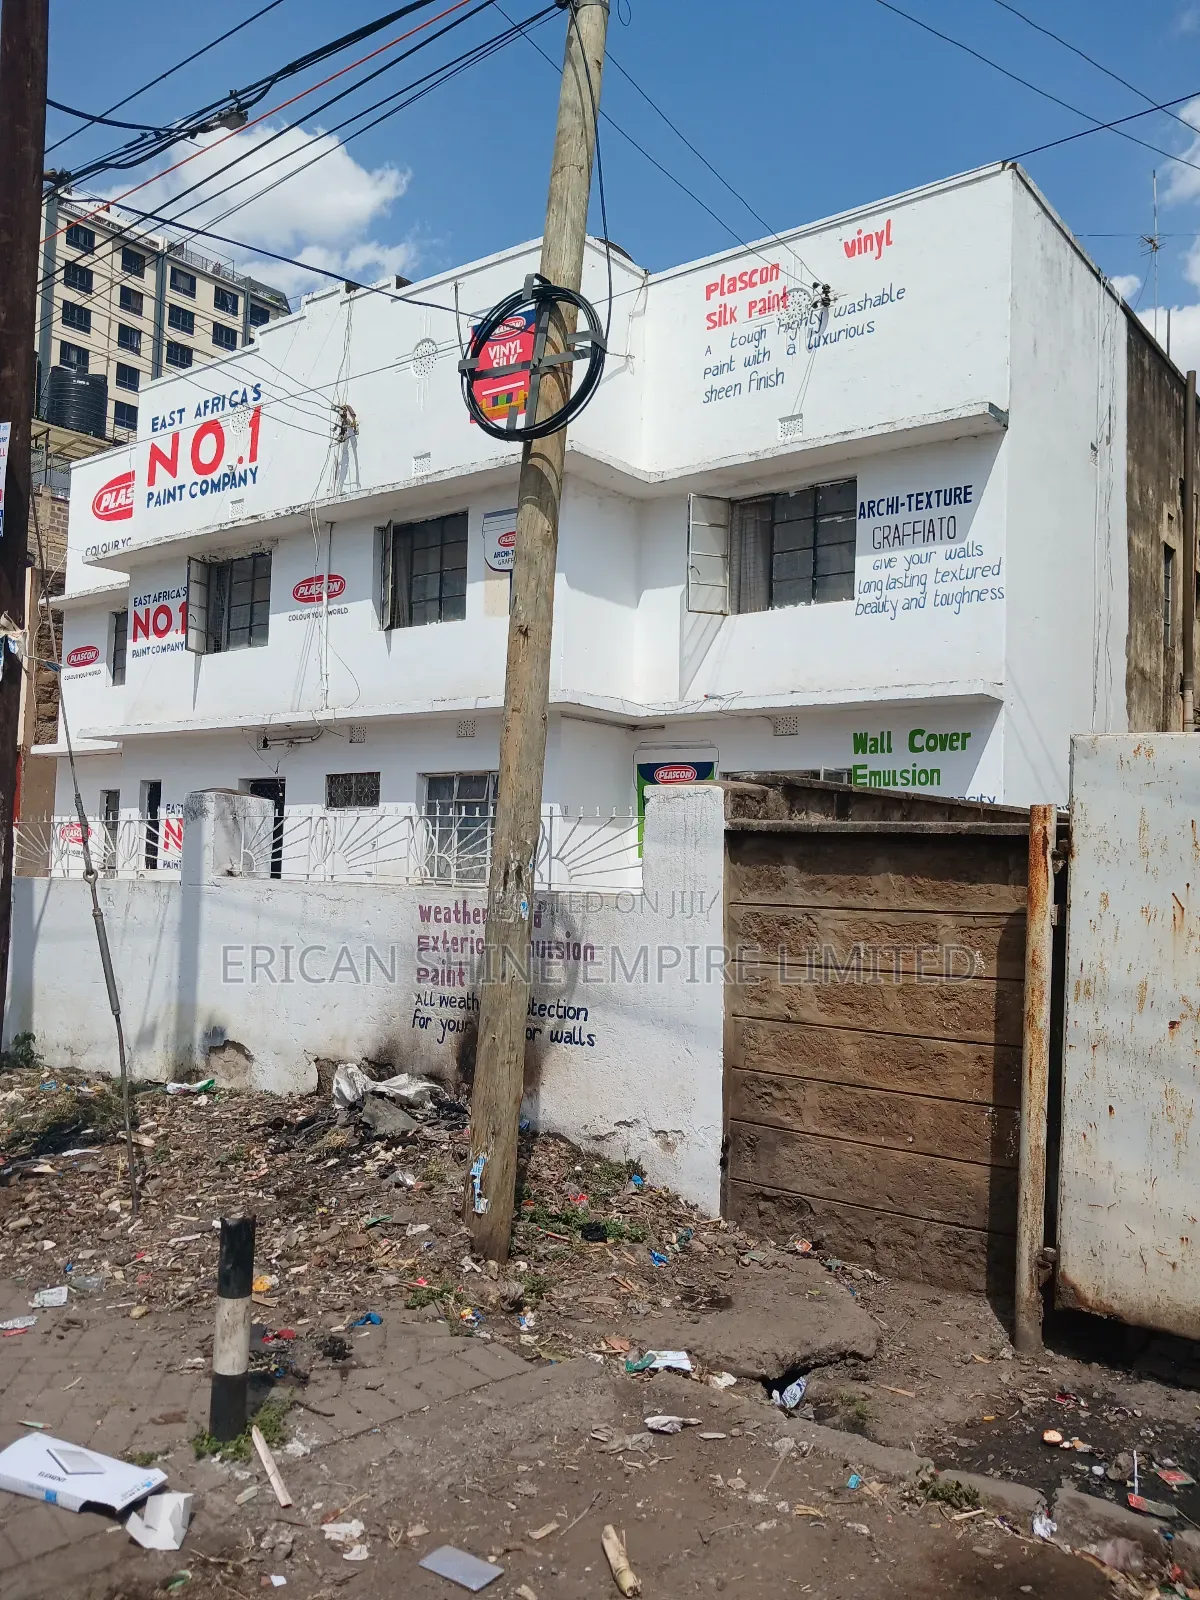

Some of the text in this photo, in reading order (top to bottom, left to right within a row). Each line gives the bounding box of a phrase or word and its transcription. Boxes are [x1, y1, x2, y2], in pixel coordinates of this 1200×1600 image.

[844, 218, 893, 260] vinyl
[730, 325, 767, 349] tough
[833, 283, 906, 318] washable
[488, 339, 523, 361] VINYL
[743, 346, 771, 368] with
[786, 343, 797, 356] a
[808, 321, 875, 350] luxurious
[703, 366, 785, 404] sheen finish
[151, 383, 262, 433] EAST AFRICA'S
[147, 405, 262, 487] NO.1
[100, 487, 135, 512] PLAS
[146, 466, 259, 509] PAINT COMPANY
[858, 484, 973, 520] ARCHI-TEXTURE
[872, 515, 957, 550] GRAFFIATO
[903, 551, 936, 572] your
[945, 540, 984, 560] walls
[934, 556, 1002, 584] textured
[133, 586, 188, 608] EAST AFRICA'S
[855, 585, 1005, 621] beauty and toughness
[132, 601, 187, 643] NO.1
[288, 612, 311, 622] COLOUR
[312, 611, 324, 619] YOU
[69, 650, 97, 664] PLASCON
[132, 641, 185, 659] PAINT COMPANY
[853, 728, 972, 755] Wall Cover
[658, 771, 693, 780] PLASCON
[852, 762, 941, 787] Emulsion
[417, 930, 486, 956] Exterio
[437, 1019, 472, 1044] your
[550, 1026, 596, 1048] walls
[38, 1471, 67, 1483] ELEMENT
